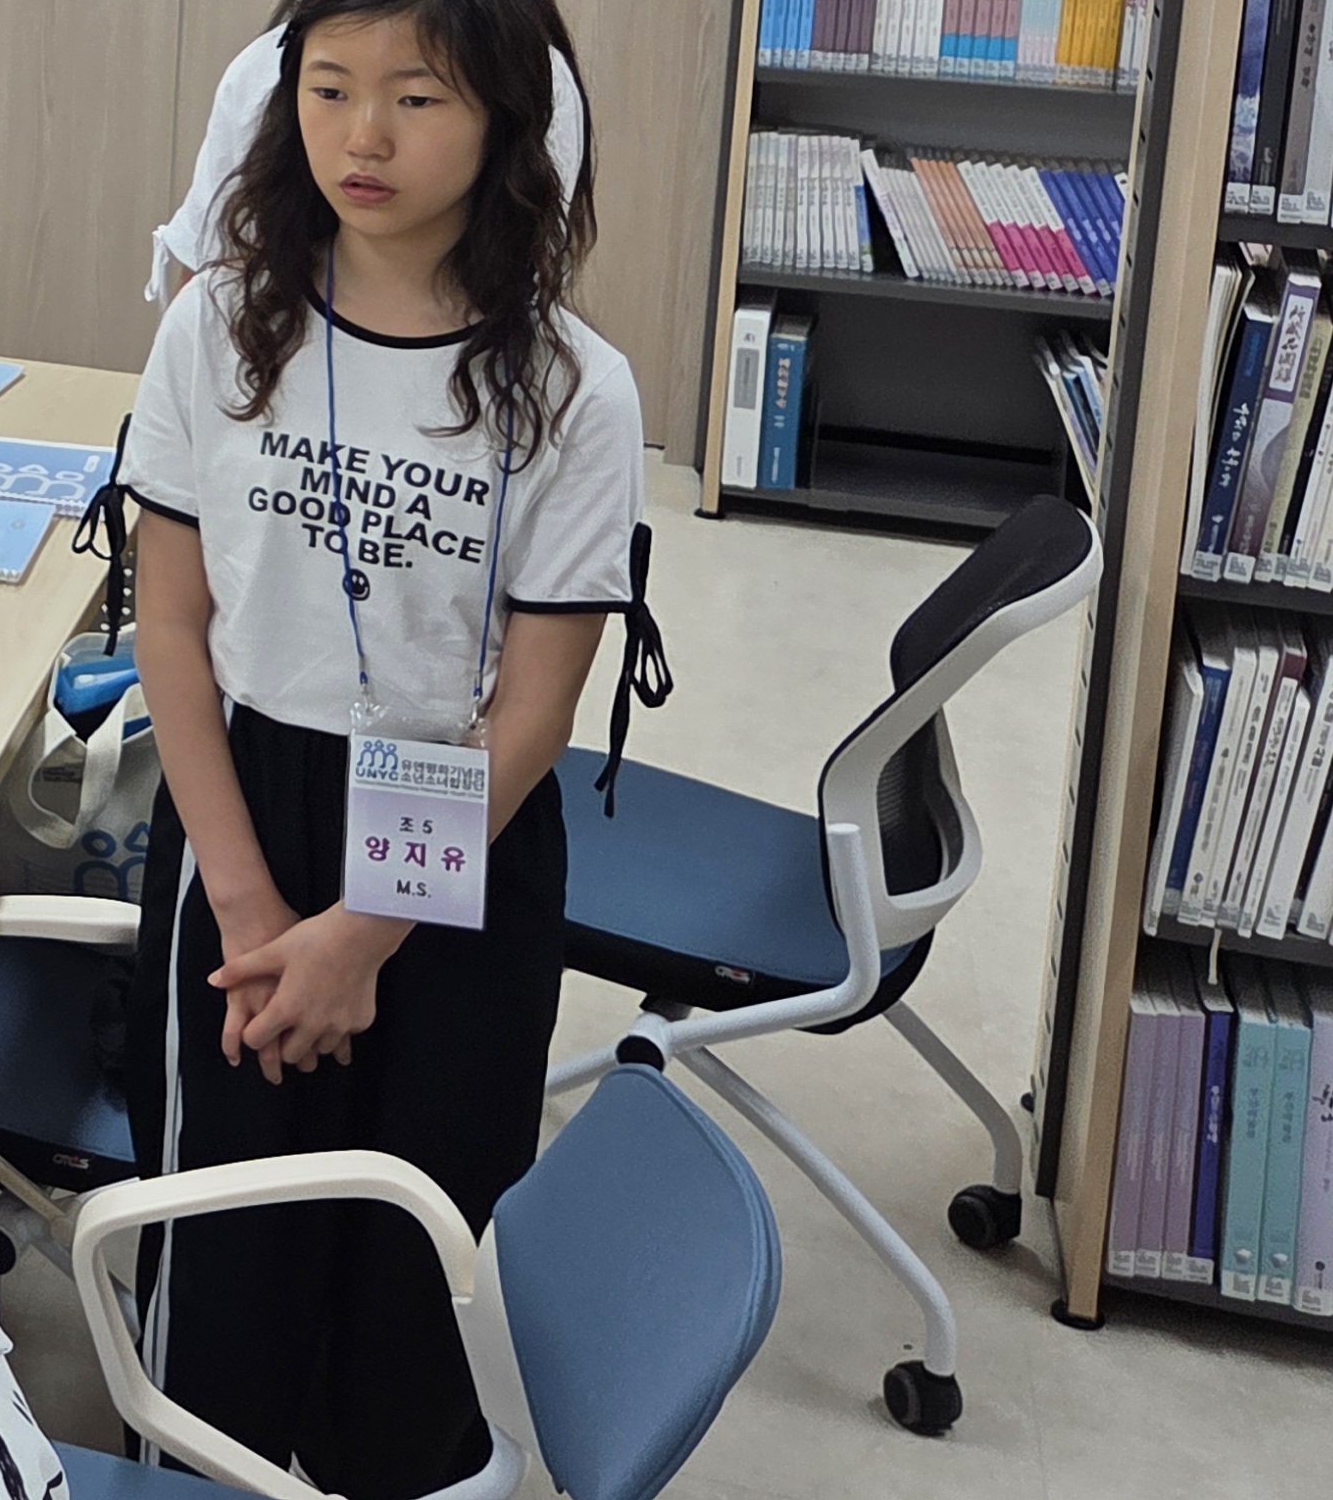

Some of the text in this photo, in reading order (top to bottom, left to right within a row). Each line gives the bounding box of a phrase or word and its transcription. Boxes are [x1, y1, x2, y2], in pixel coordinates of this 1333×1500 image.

[259, 430, 491, 507] MAKE YOUR
[404, 492, 433, 522] A
[247, 485, 486, 565] GOOD PLACE
[301, 521, 414, 569] TO BE.
[354, 766, 399, 782] UNYC
[398, 816, 434, 835] 조 5
[395, 878, 433, 899] M.S.
